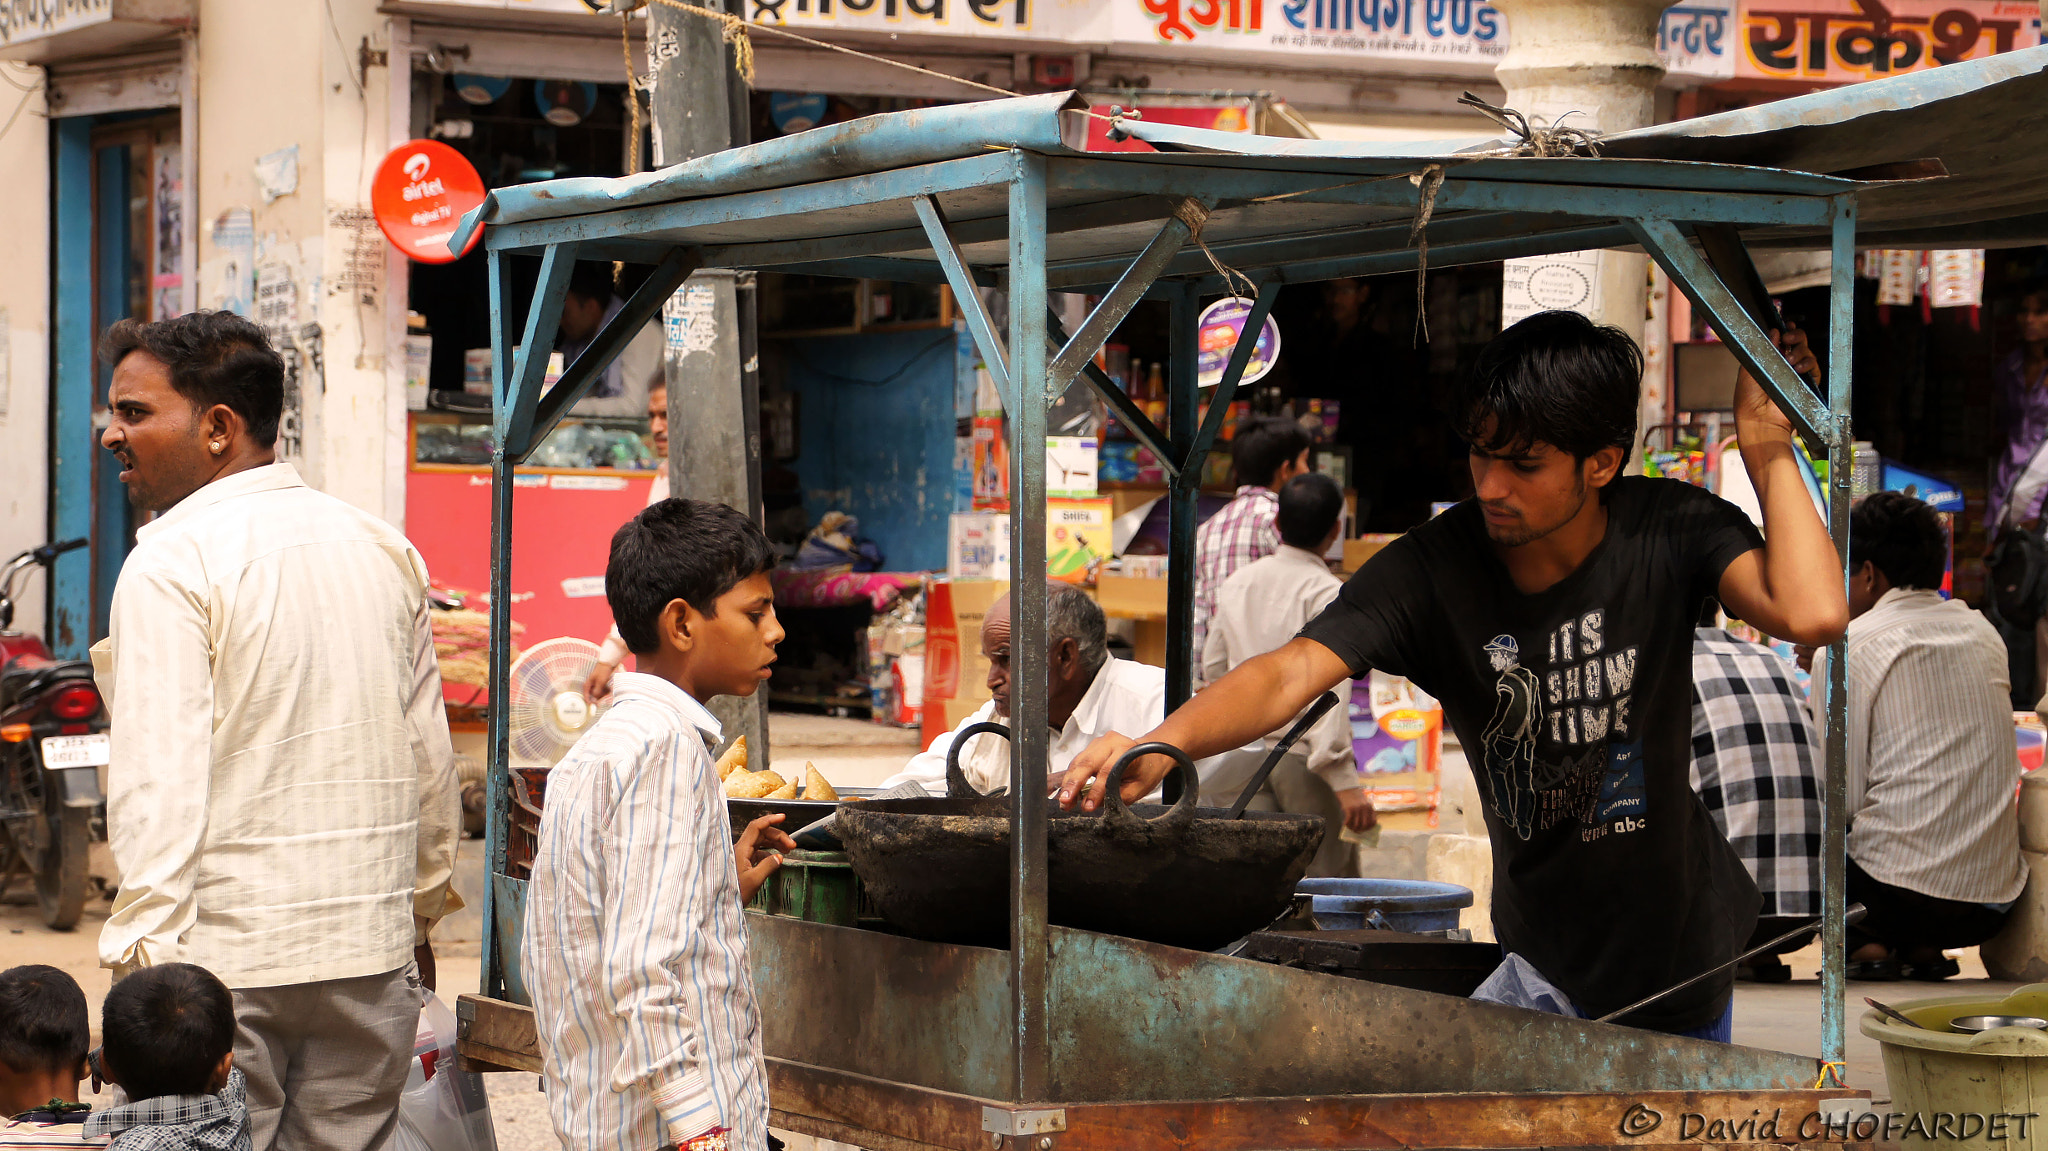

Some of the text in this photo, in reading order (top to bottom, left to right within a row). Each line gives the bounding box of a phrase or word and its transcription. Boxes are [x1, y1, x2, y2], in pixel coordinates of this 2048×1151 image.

[402, 177, 445, 201] airtel
[1549, 612, 1603, 663] ITS
[1548, 647, 1637, 705] SHOW
[1547, 696, 1631, 743] TIME
[1602, 798, 1641, 816] COMPANY
[1614, 816, 1646, 833] abc
